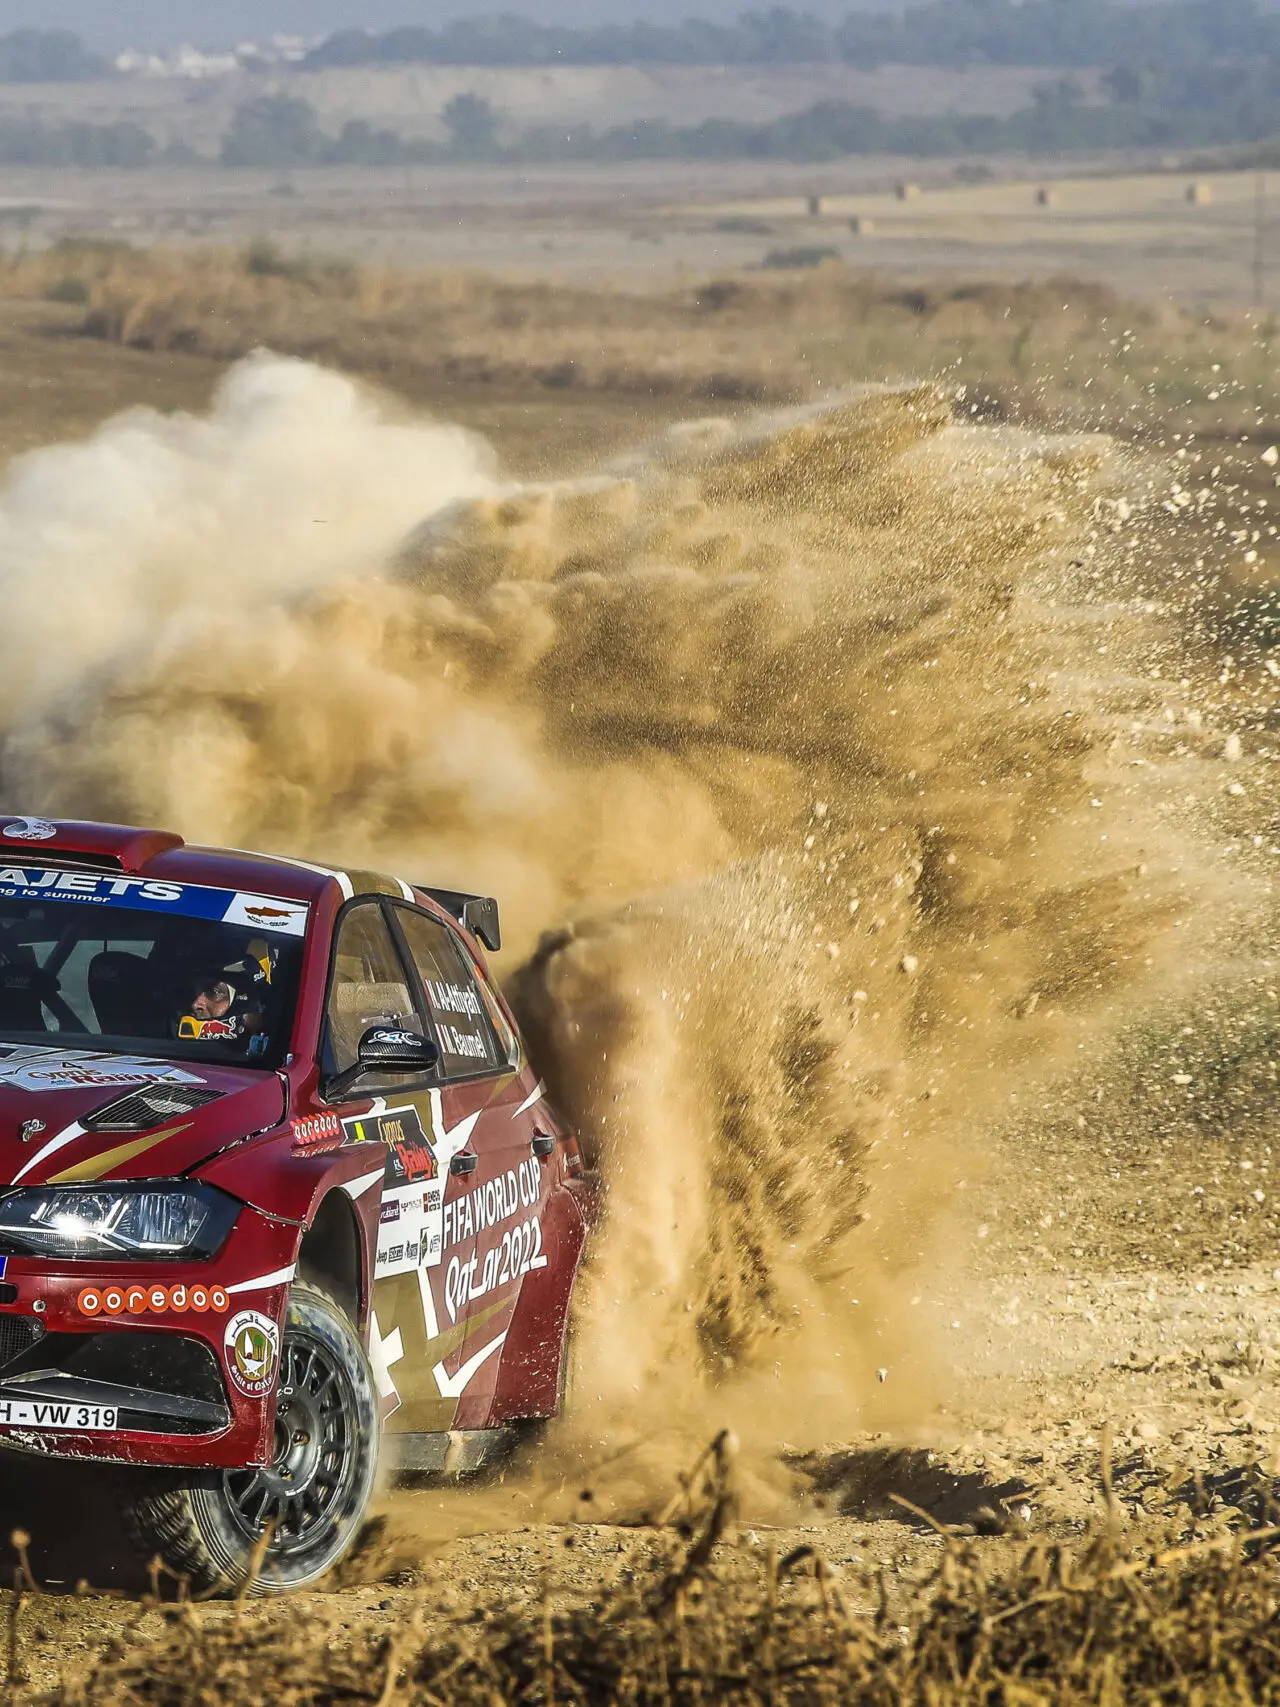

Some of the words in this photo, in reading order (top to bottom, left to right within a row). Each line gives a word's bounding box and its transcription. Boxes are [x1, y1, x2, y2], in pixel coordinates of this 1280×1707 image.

[21, 888, 39, 896] to
[43, 891, 111, 903] summer
[69, 1073, 159, 1084] Rally
[294, 1114, 338, 1140] ooredoo
[377, 1117, 406, 1152] Cyprus
[443, 1193, 474, 1250] FIFA
[473, 1170, 519, 1232] WORLD
[519, 1156, 542, 1208] CUP
[445, 1244, 503, 1324] Qatar
[499, 1216, 548, 1286] 2022
[82, 1284, 226, 1311] ooredoo
[231, 1364, 246, 1388] State
[246, 1383, 254, 1391] of
[33, 1404, 71, 1425] VW
[77, 1407, 115, 1428] 319
